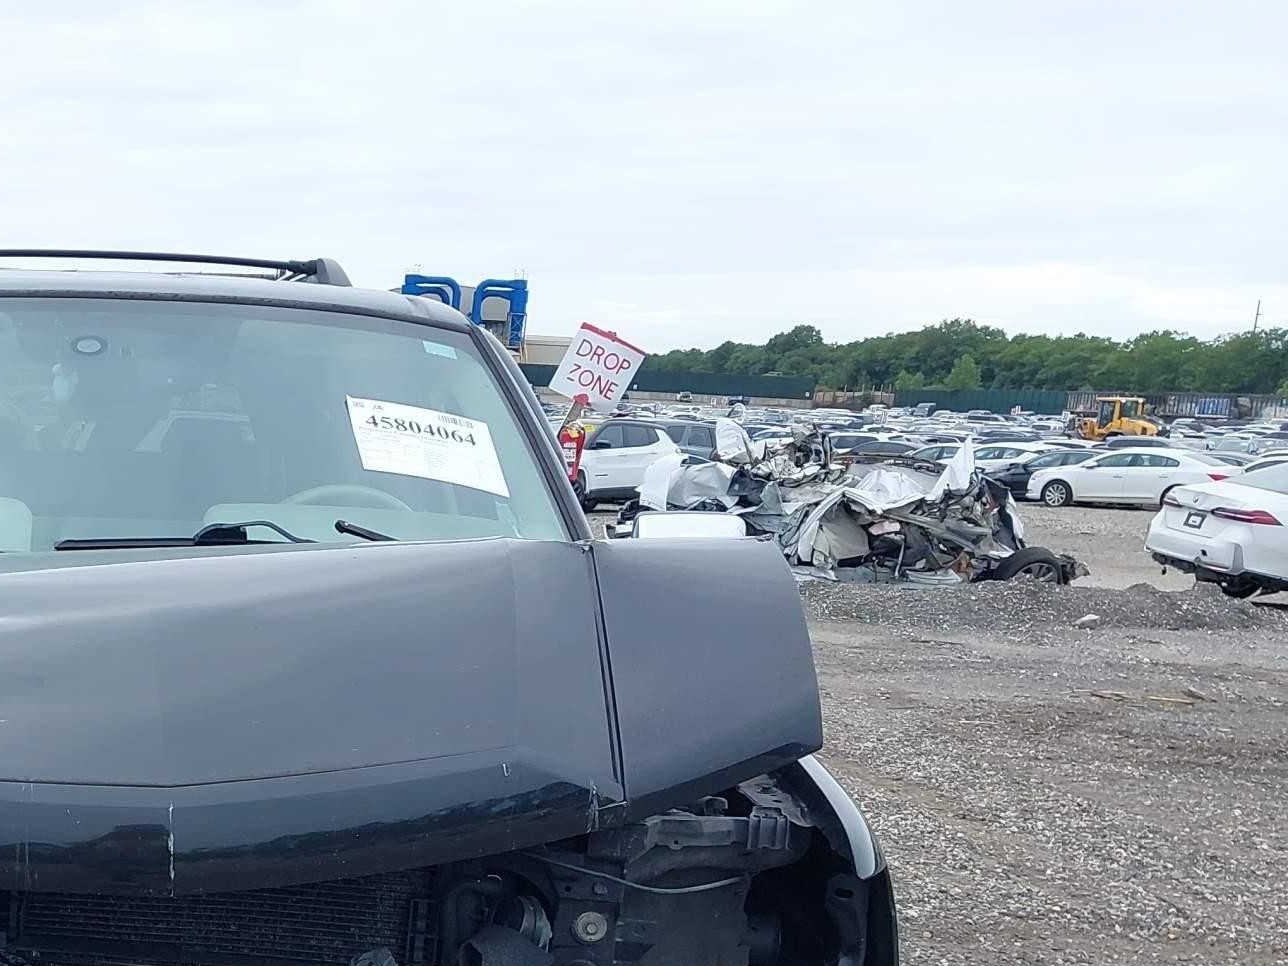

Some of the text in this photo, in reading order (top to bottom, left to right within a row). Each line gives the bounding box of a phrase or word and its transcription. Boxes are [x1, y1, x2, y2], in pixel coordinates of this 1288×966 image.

[575, 338, 632, 375] DROP
[566, 363, 619, 401] ZONE
[365, 414, 476, 446] 45804064
